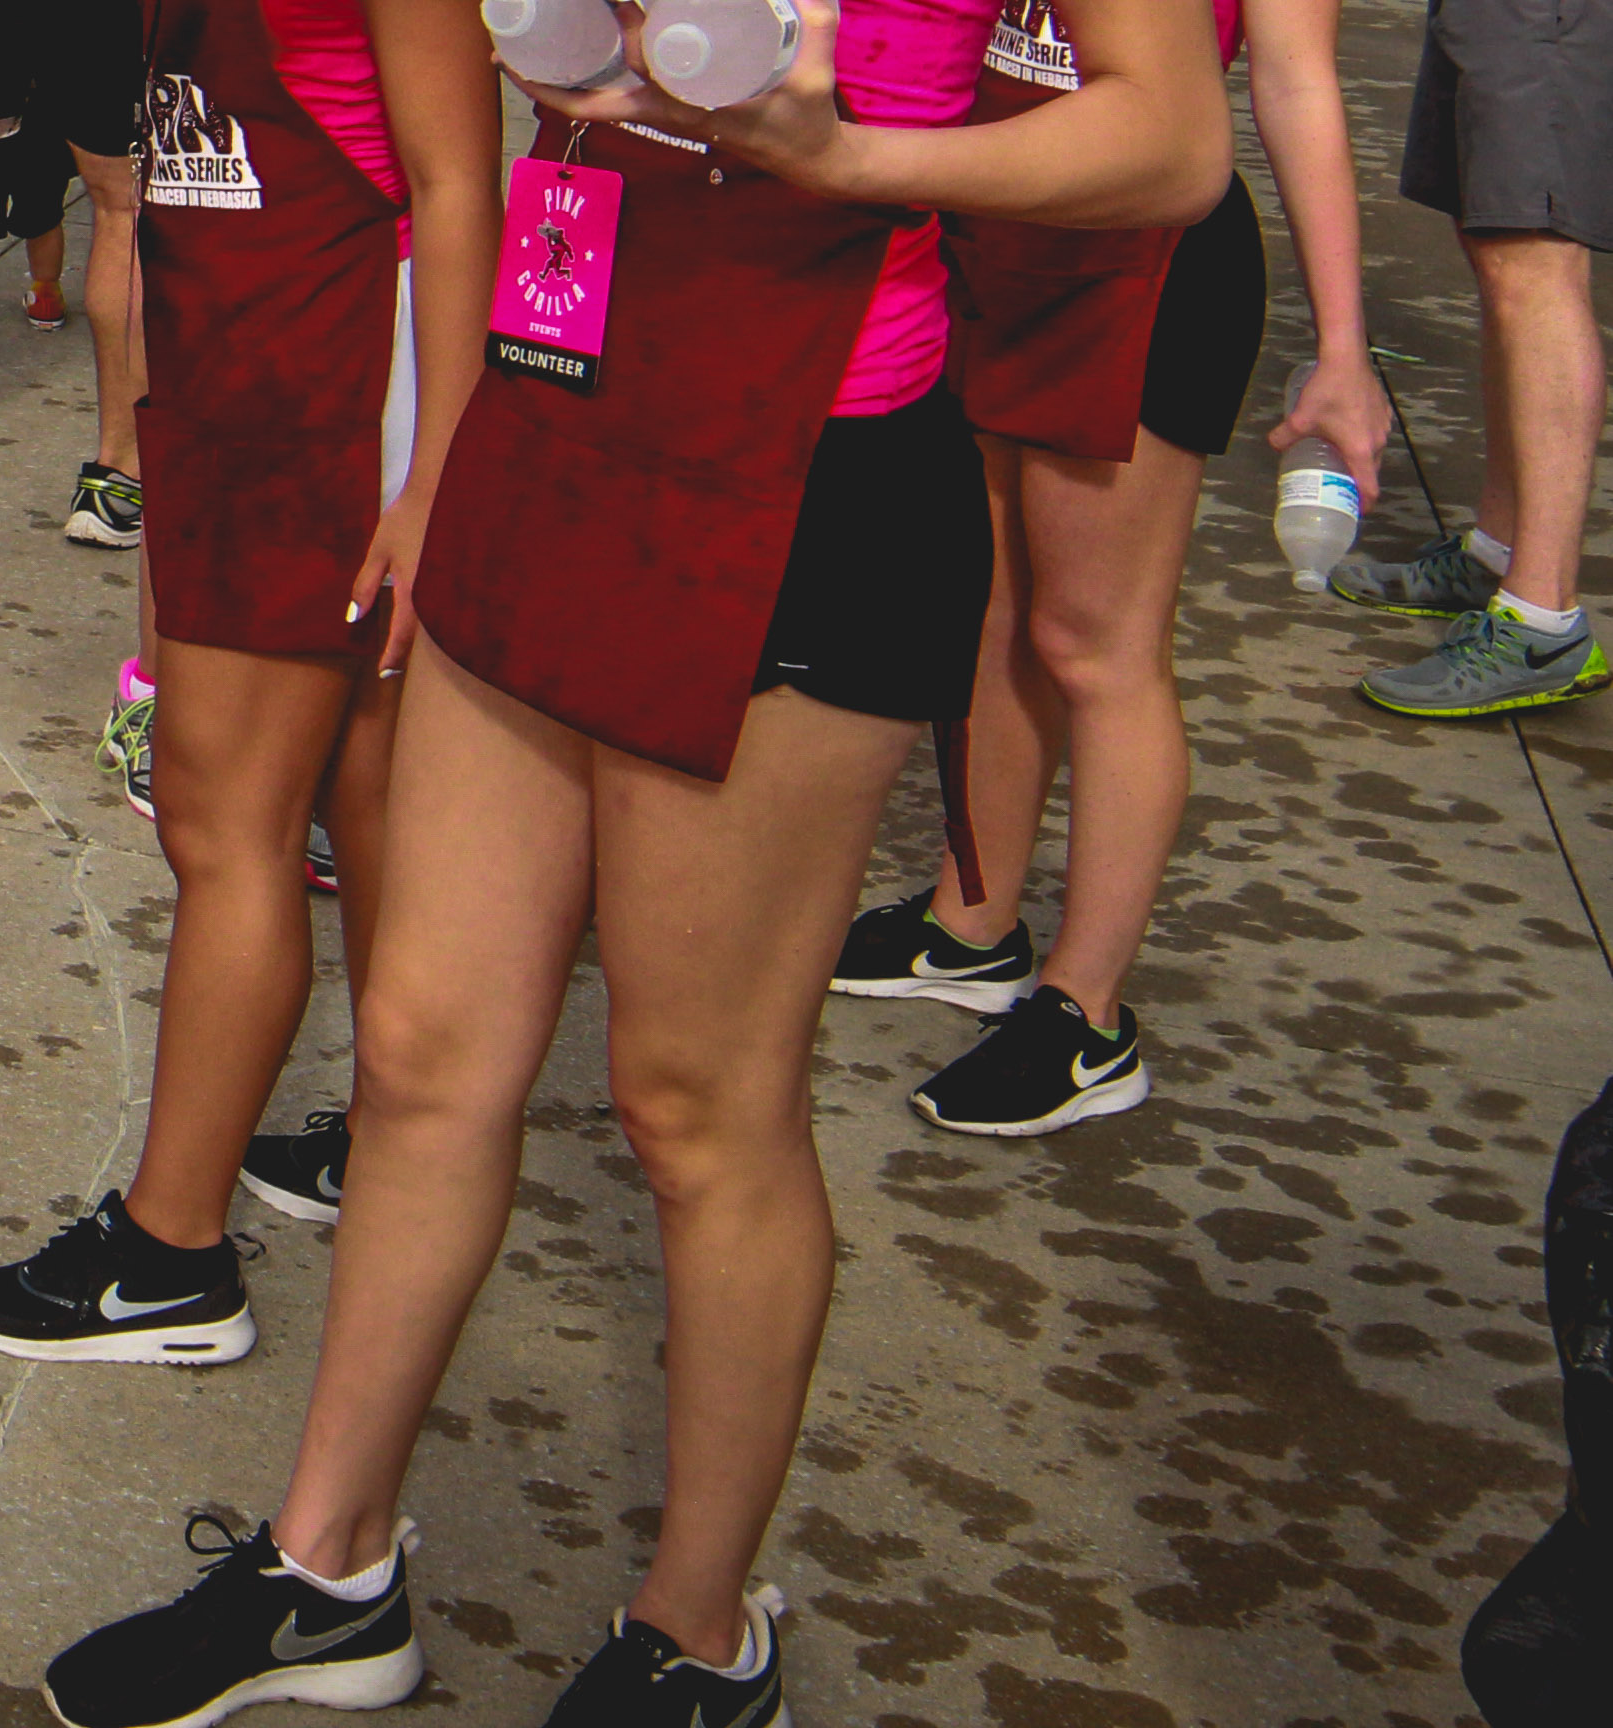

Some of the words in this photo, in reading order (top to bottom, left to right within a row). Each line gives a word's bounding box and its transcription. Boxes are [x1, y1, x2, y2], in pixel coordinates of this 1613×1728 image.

[1025, 40, 1074, 68] SERIE
[1033, 70, 1079, 92] NEBRAS
[184, 156, 243, 184] SERIES
[152, 187, 187, 206] RACED
[188, 189, 200, 207] IN
[200, 190, 262, 209] NEBRASKA
[544, 186, 585, 219] PINK
[517, 270, 585, 316] GORILLA
[529, 322, 562, 338] EVENTS
[499, 342, 585, 378] VOLUNTEER
